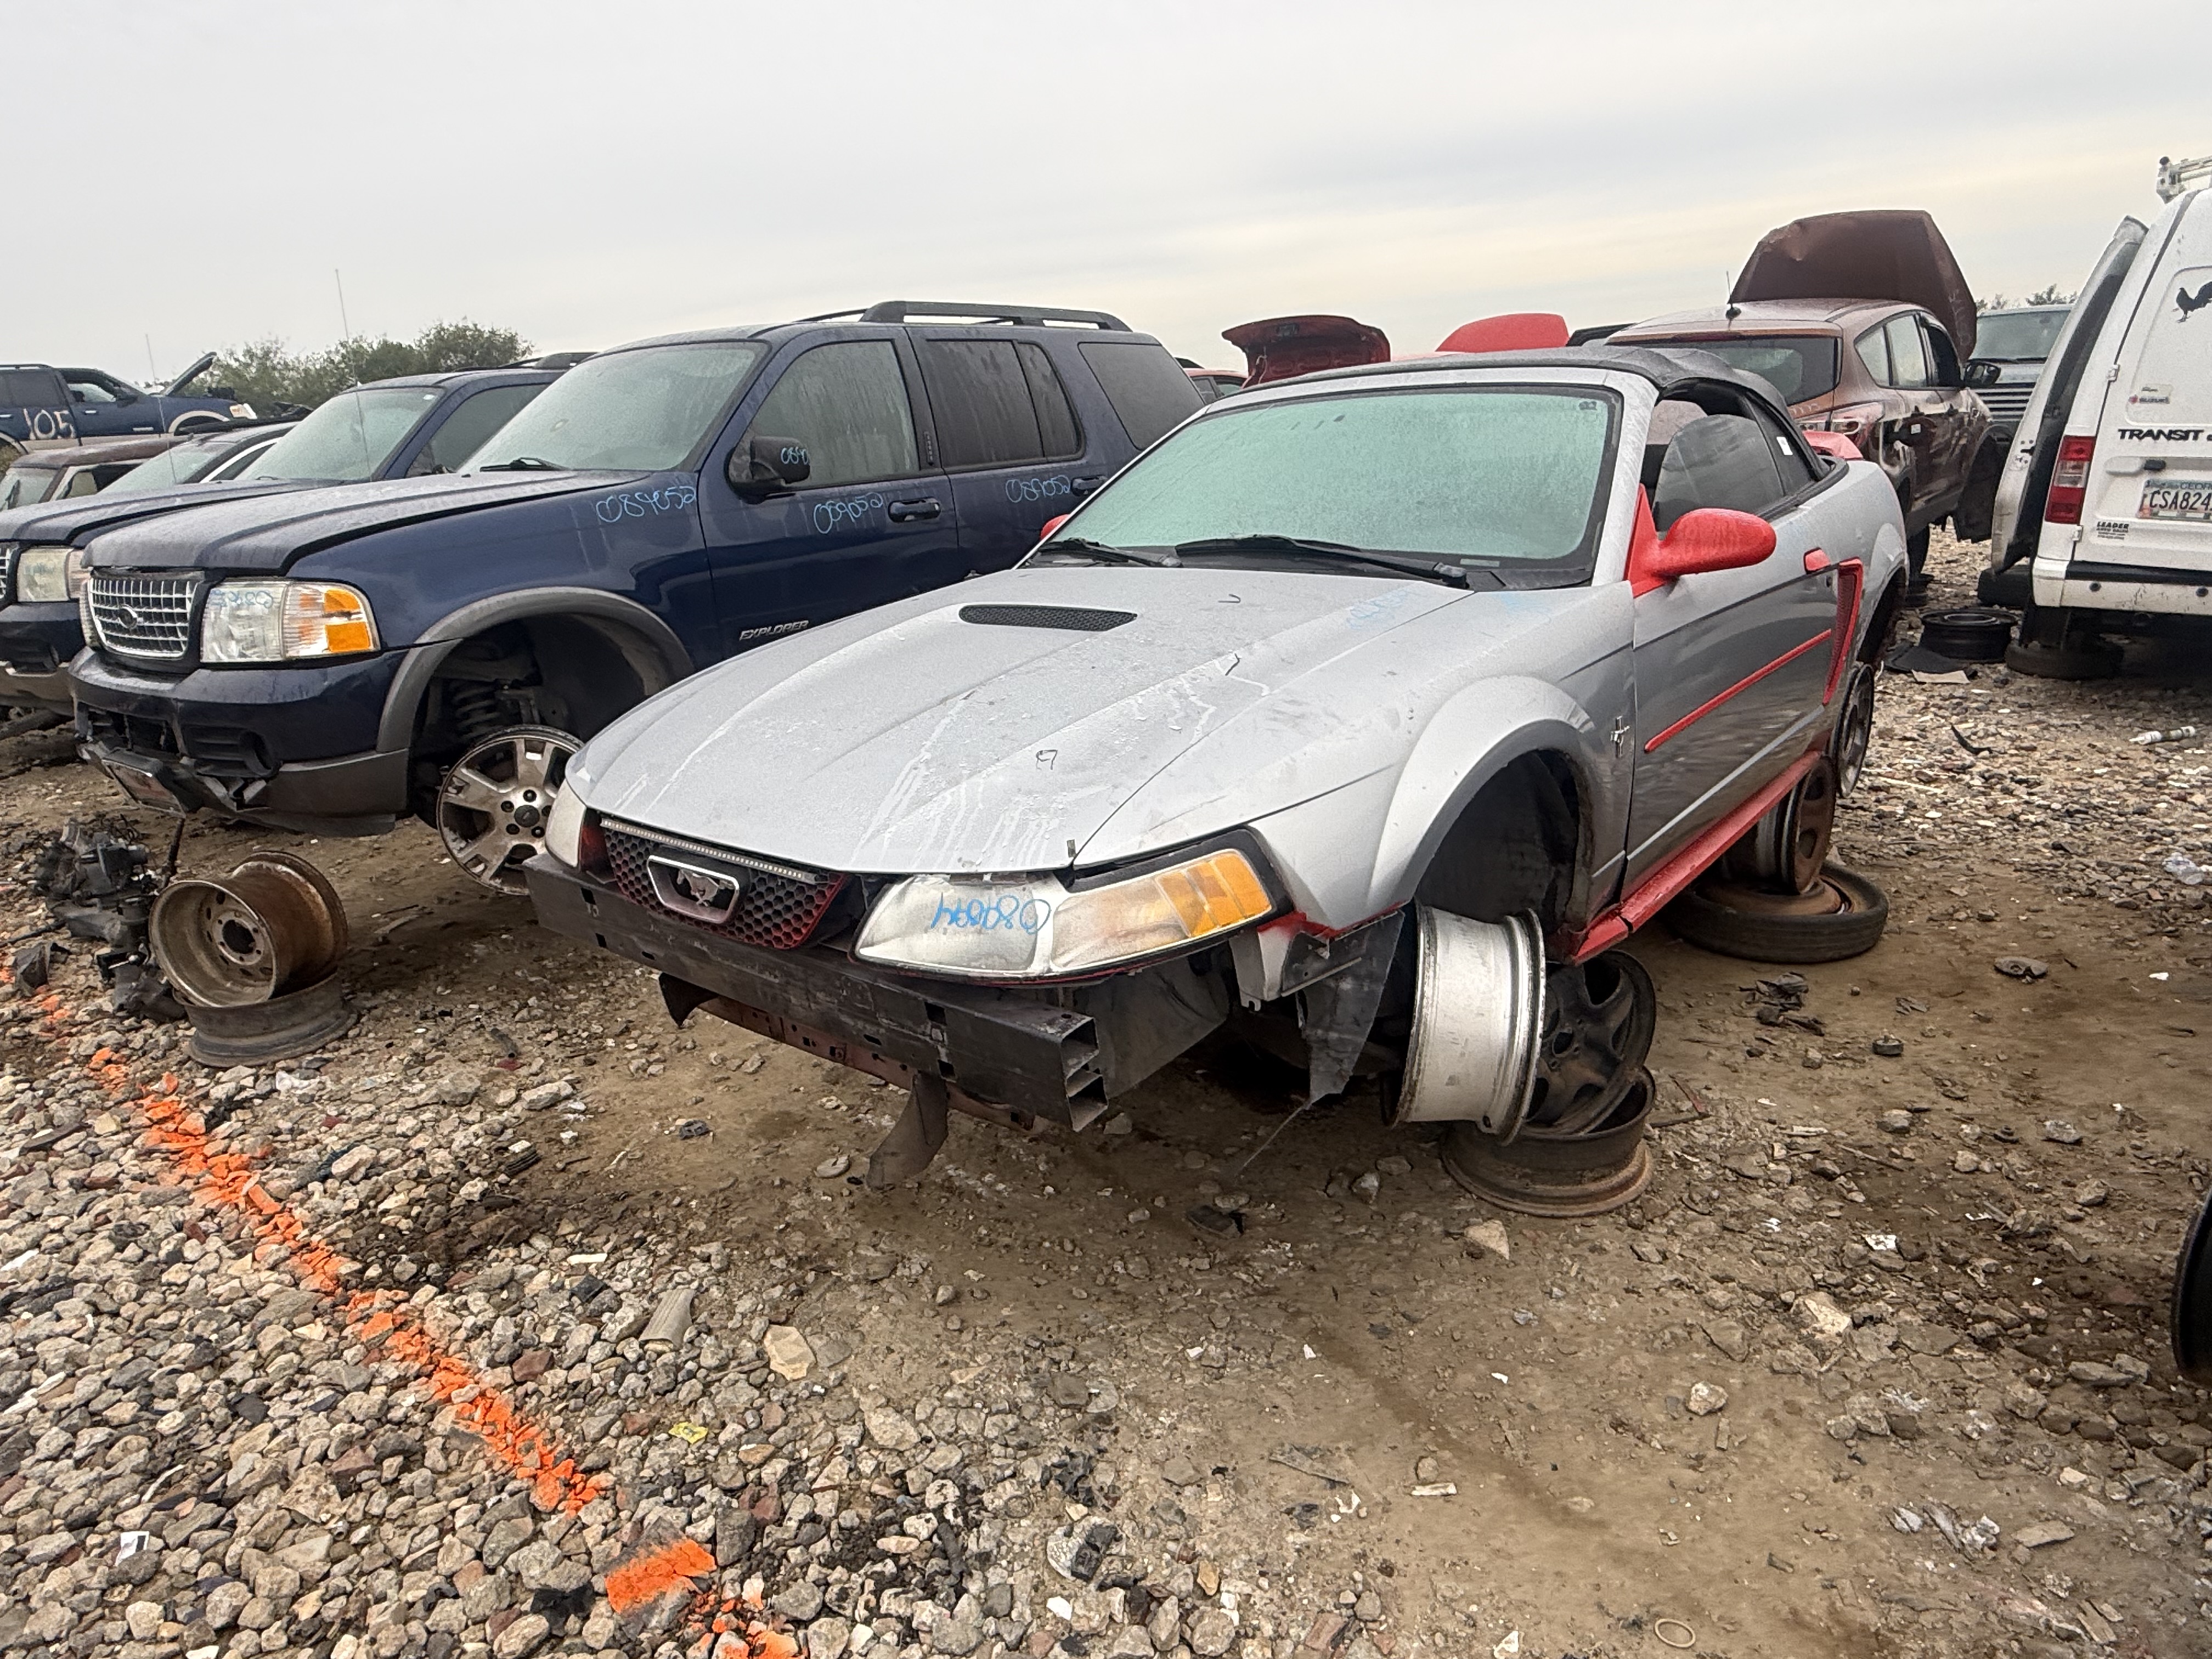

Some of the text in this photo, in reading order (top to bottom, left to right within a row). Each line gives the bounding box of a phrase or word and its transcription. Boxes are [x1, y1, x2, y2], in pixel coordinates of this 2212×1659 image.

[24, 408, 76, 440] 105
[2118, 429, 2204, 441] TRANSIT
[2149, 489, 2212, 511] CSA824
[739, 620, 809, 641] EXPLORER
